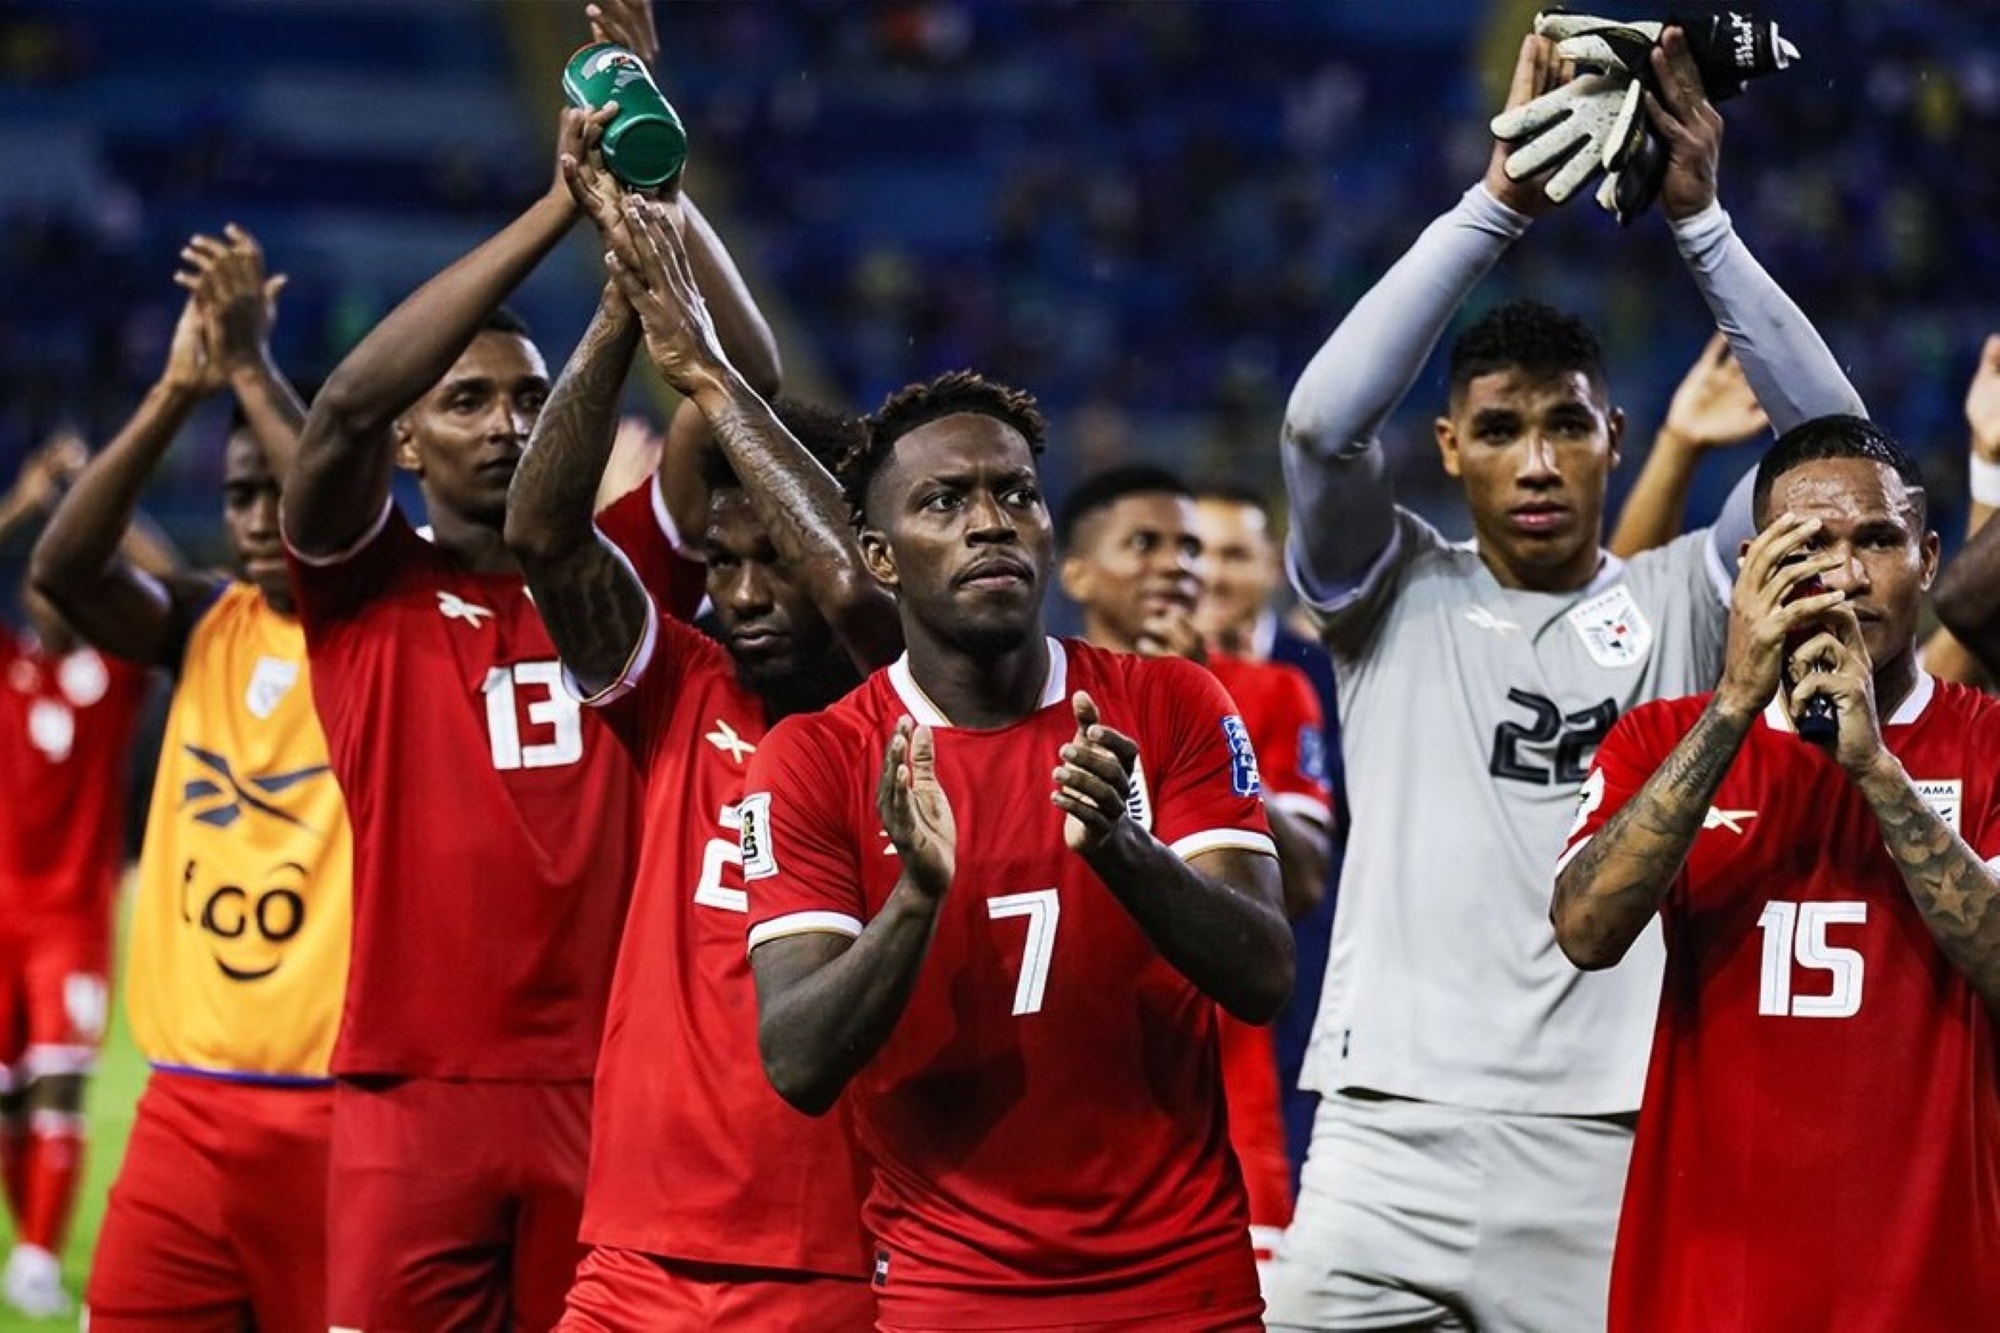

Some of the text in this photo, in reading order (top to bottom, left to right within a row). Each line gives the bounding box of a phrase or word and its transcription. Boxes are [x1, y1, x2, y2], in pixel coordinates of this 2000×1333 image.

[482, 662, 583, 770] 13
[1490, 687, 1617, 786] 22
[1919, 786, 1954, 795] AMA
[986, 888, 1060, 1016] 7
[1756, 900, 1867, 1018] 15
